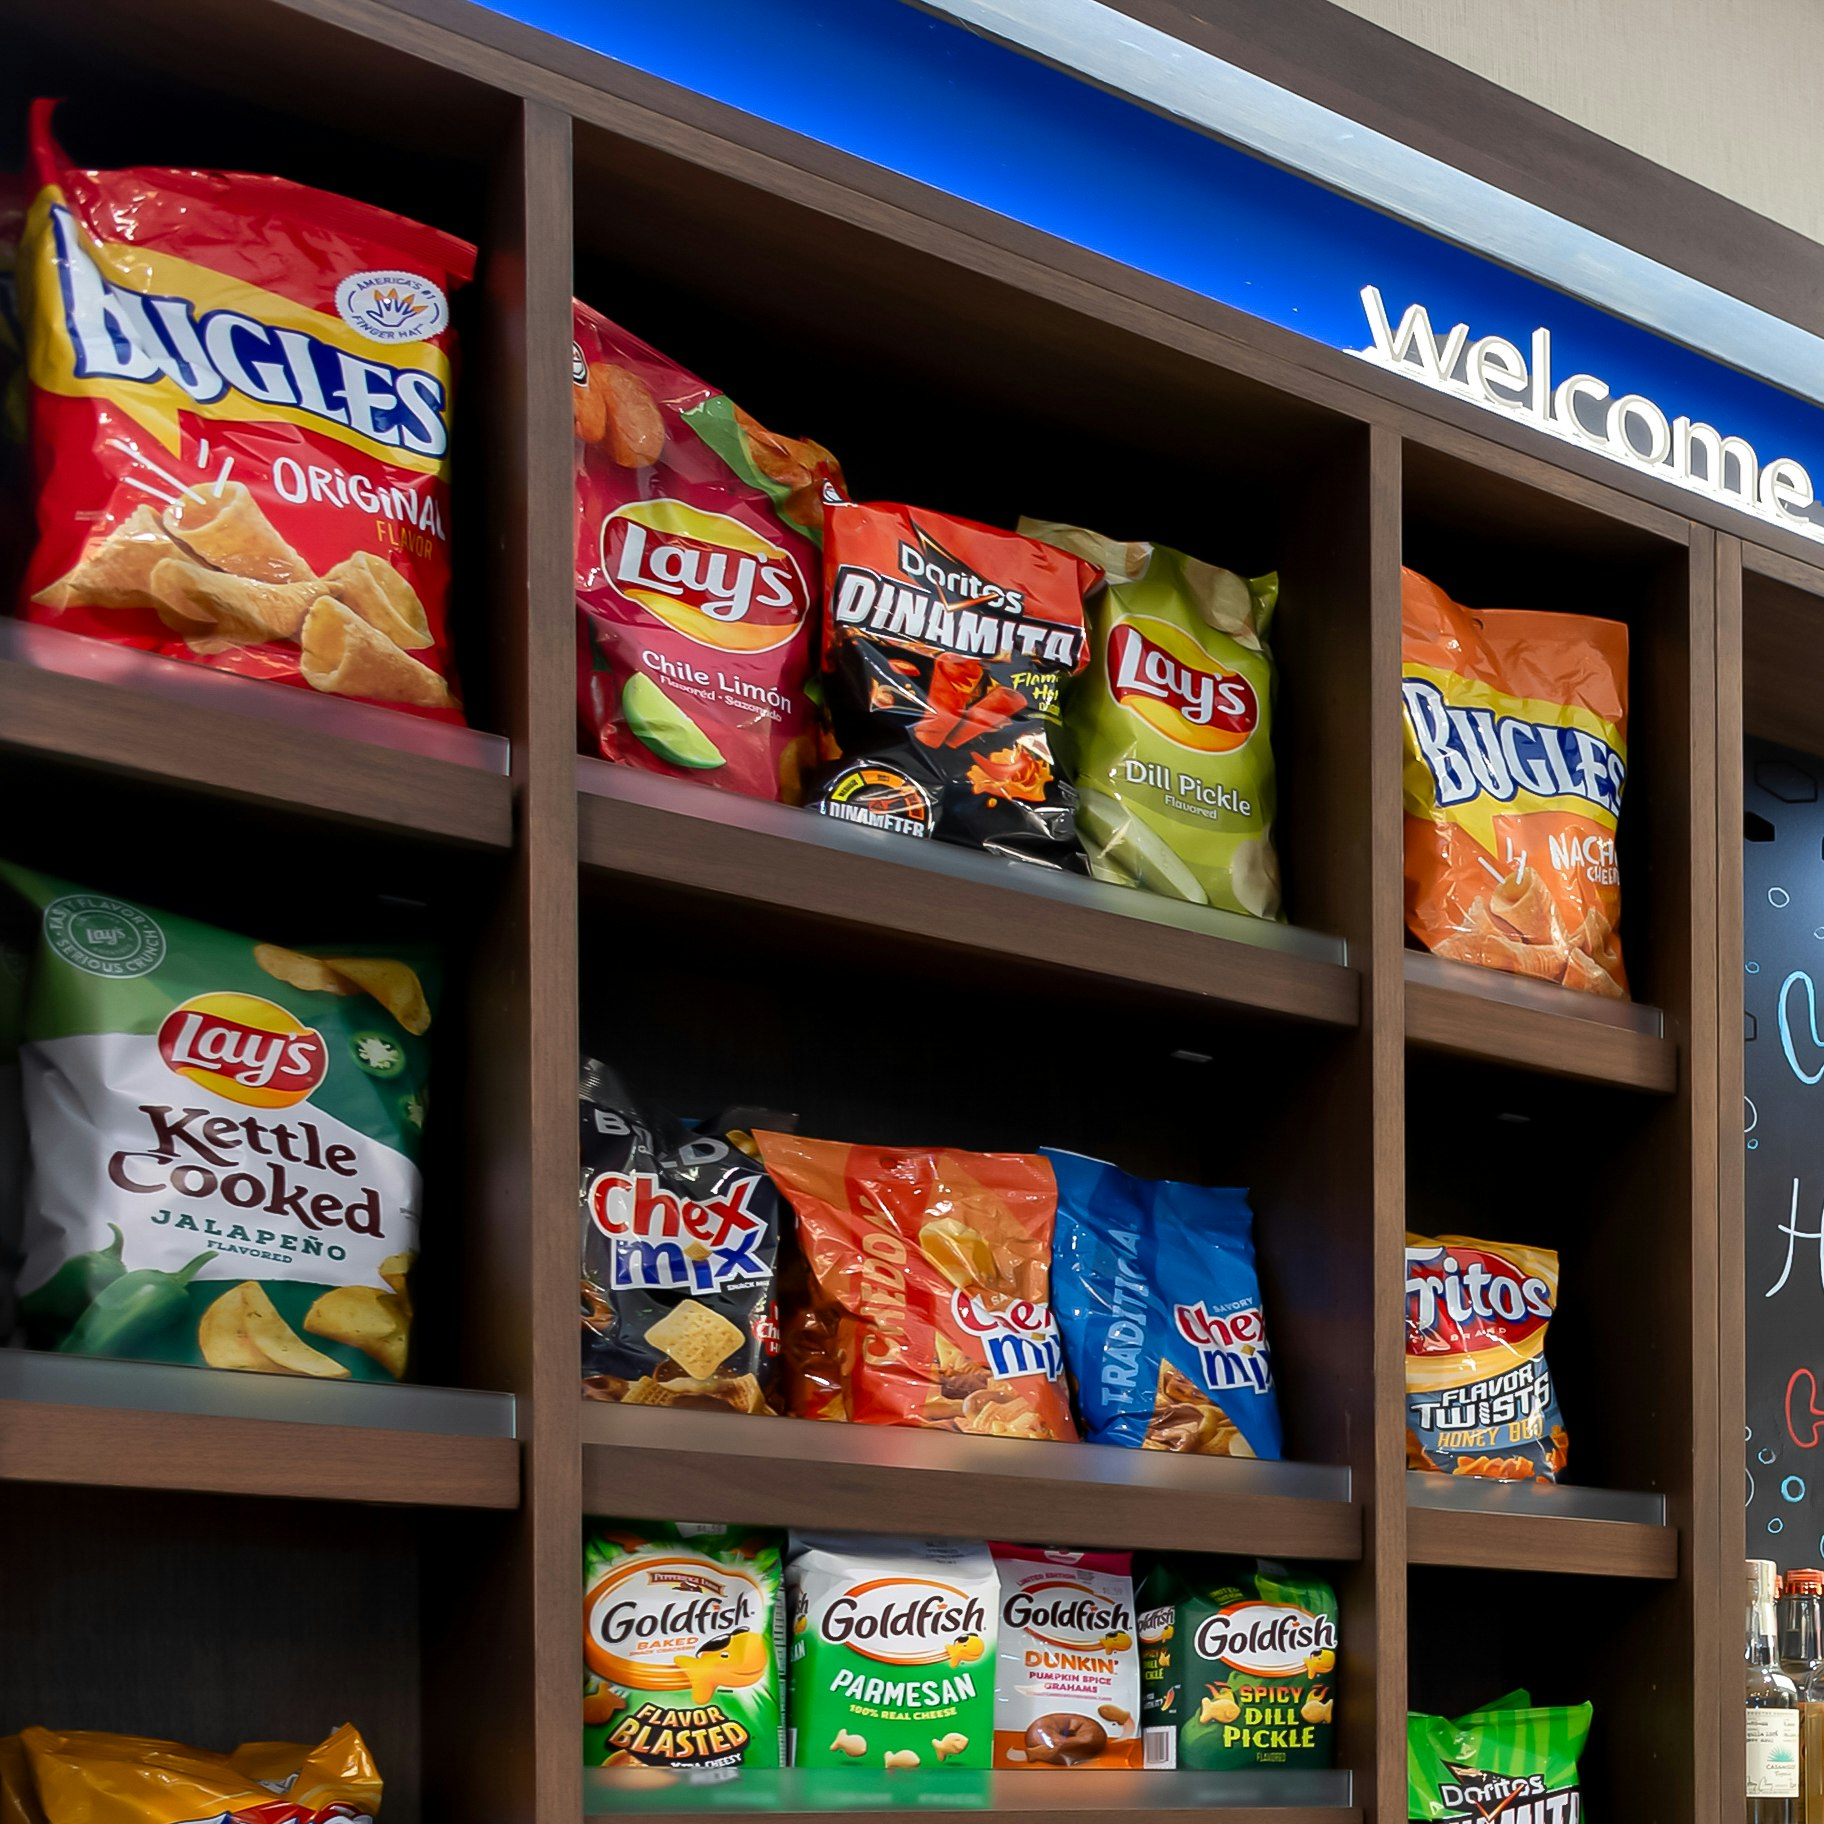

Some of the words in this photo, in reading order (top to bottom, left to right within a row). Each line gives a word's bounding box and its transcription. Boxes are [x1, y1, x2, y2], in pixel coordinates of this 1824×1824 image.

[356, 277, 423, 291] AMERICA'S
[51, 203, 447, 458] BUGLES
[352, 315, 395, 339] FINGER
[398, 324, 424, 338] HAT
[1358, 285, 1814, 524] welcome
[377, 520, 433, 561] FLAVOR
[613, 522, 793, 621] Lay's
[901, 543, 1024, 614] Doritos
[836, 573, 1077, 666] DINAMITA
[642, 649, 712, 688] Chile
[717, 665, 793, 715] Limón
[1115, 627, 1247, 724] Lay's
[1402, 678, 1628, 817] BUGLES
[1125, 760, 1171, 792] Dill
[1178, 774, 1251, 817] Pickle
[1164, 795, 1218, 820] Flavored
[171, 1013, 318, 1086] Lay's
[138, 1105, 358, 1177] Kettle
[108, 1151, 385, 1239] Cooked
[594, 1175, 760, 1248] Chex
[151, 1209, 347, 1262] JALAPEÑO
[207, 1239, 293, 1265] FLAVORED
[615, 1230, 765, 1290] mix
[1213, 1297, 1254, 1314] SAVORY
[1409, 1371, 1551, 1430] TWISTS
[1441, 1363, 1534, 1407] FLAVOR
[1437, 1430, 1498, 1448] HONEY
[600, 1591, 750, 1644] Goldfish
[822, 1595, 985, 1642] Goldfish
[1003, 1593, 1131, 1633] Goldfish
[636, 1636, 699, 1650] BAKED
[1197, 1613, 1336, 1657] Goldfish
[1024, 1649, 1119, 1675] DUNKIN'
[1029, 1671, 1080, 1683] PUMPKIN
[1082, 1675, 1112, 1686] SPICE
[830, 1669, 976, 1708] PARMESAN
[1043, 1682, 1099, 1694] GRAHAMS
[1239, 1686, 1303, 1704] SPICY
[636, 1704, 727, 1729] FLAVOR
[849, 1704, 879, 1718] 100%
[881, 1710, 911, 1720] REAL
[913, 1706, 957, 1720] CHEESE
[1244, 1708, 1300, 1726] DILL
[609, 1717, 750, 1759] BLASTED
[1223, 1725, 1316, 1749] PICKLE
[1442, 1775, 1544, 1808] Doritos
